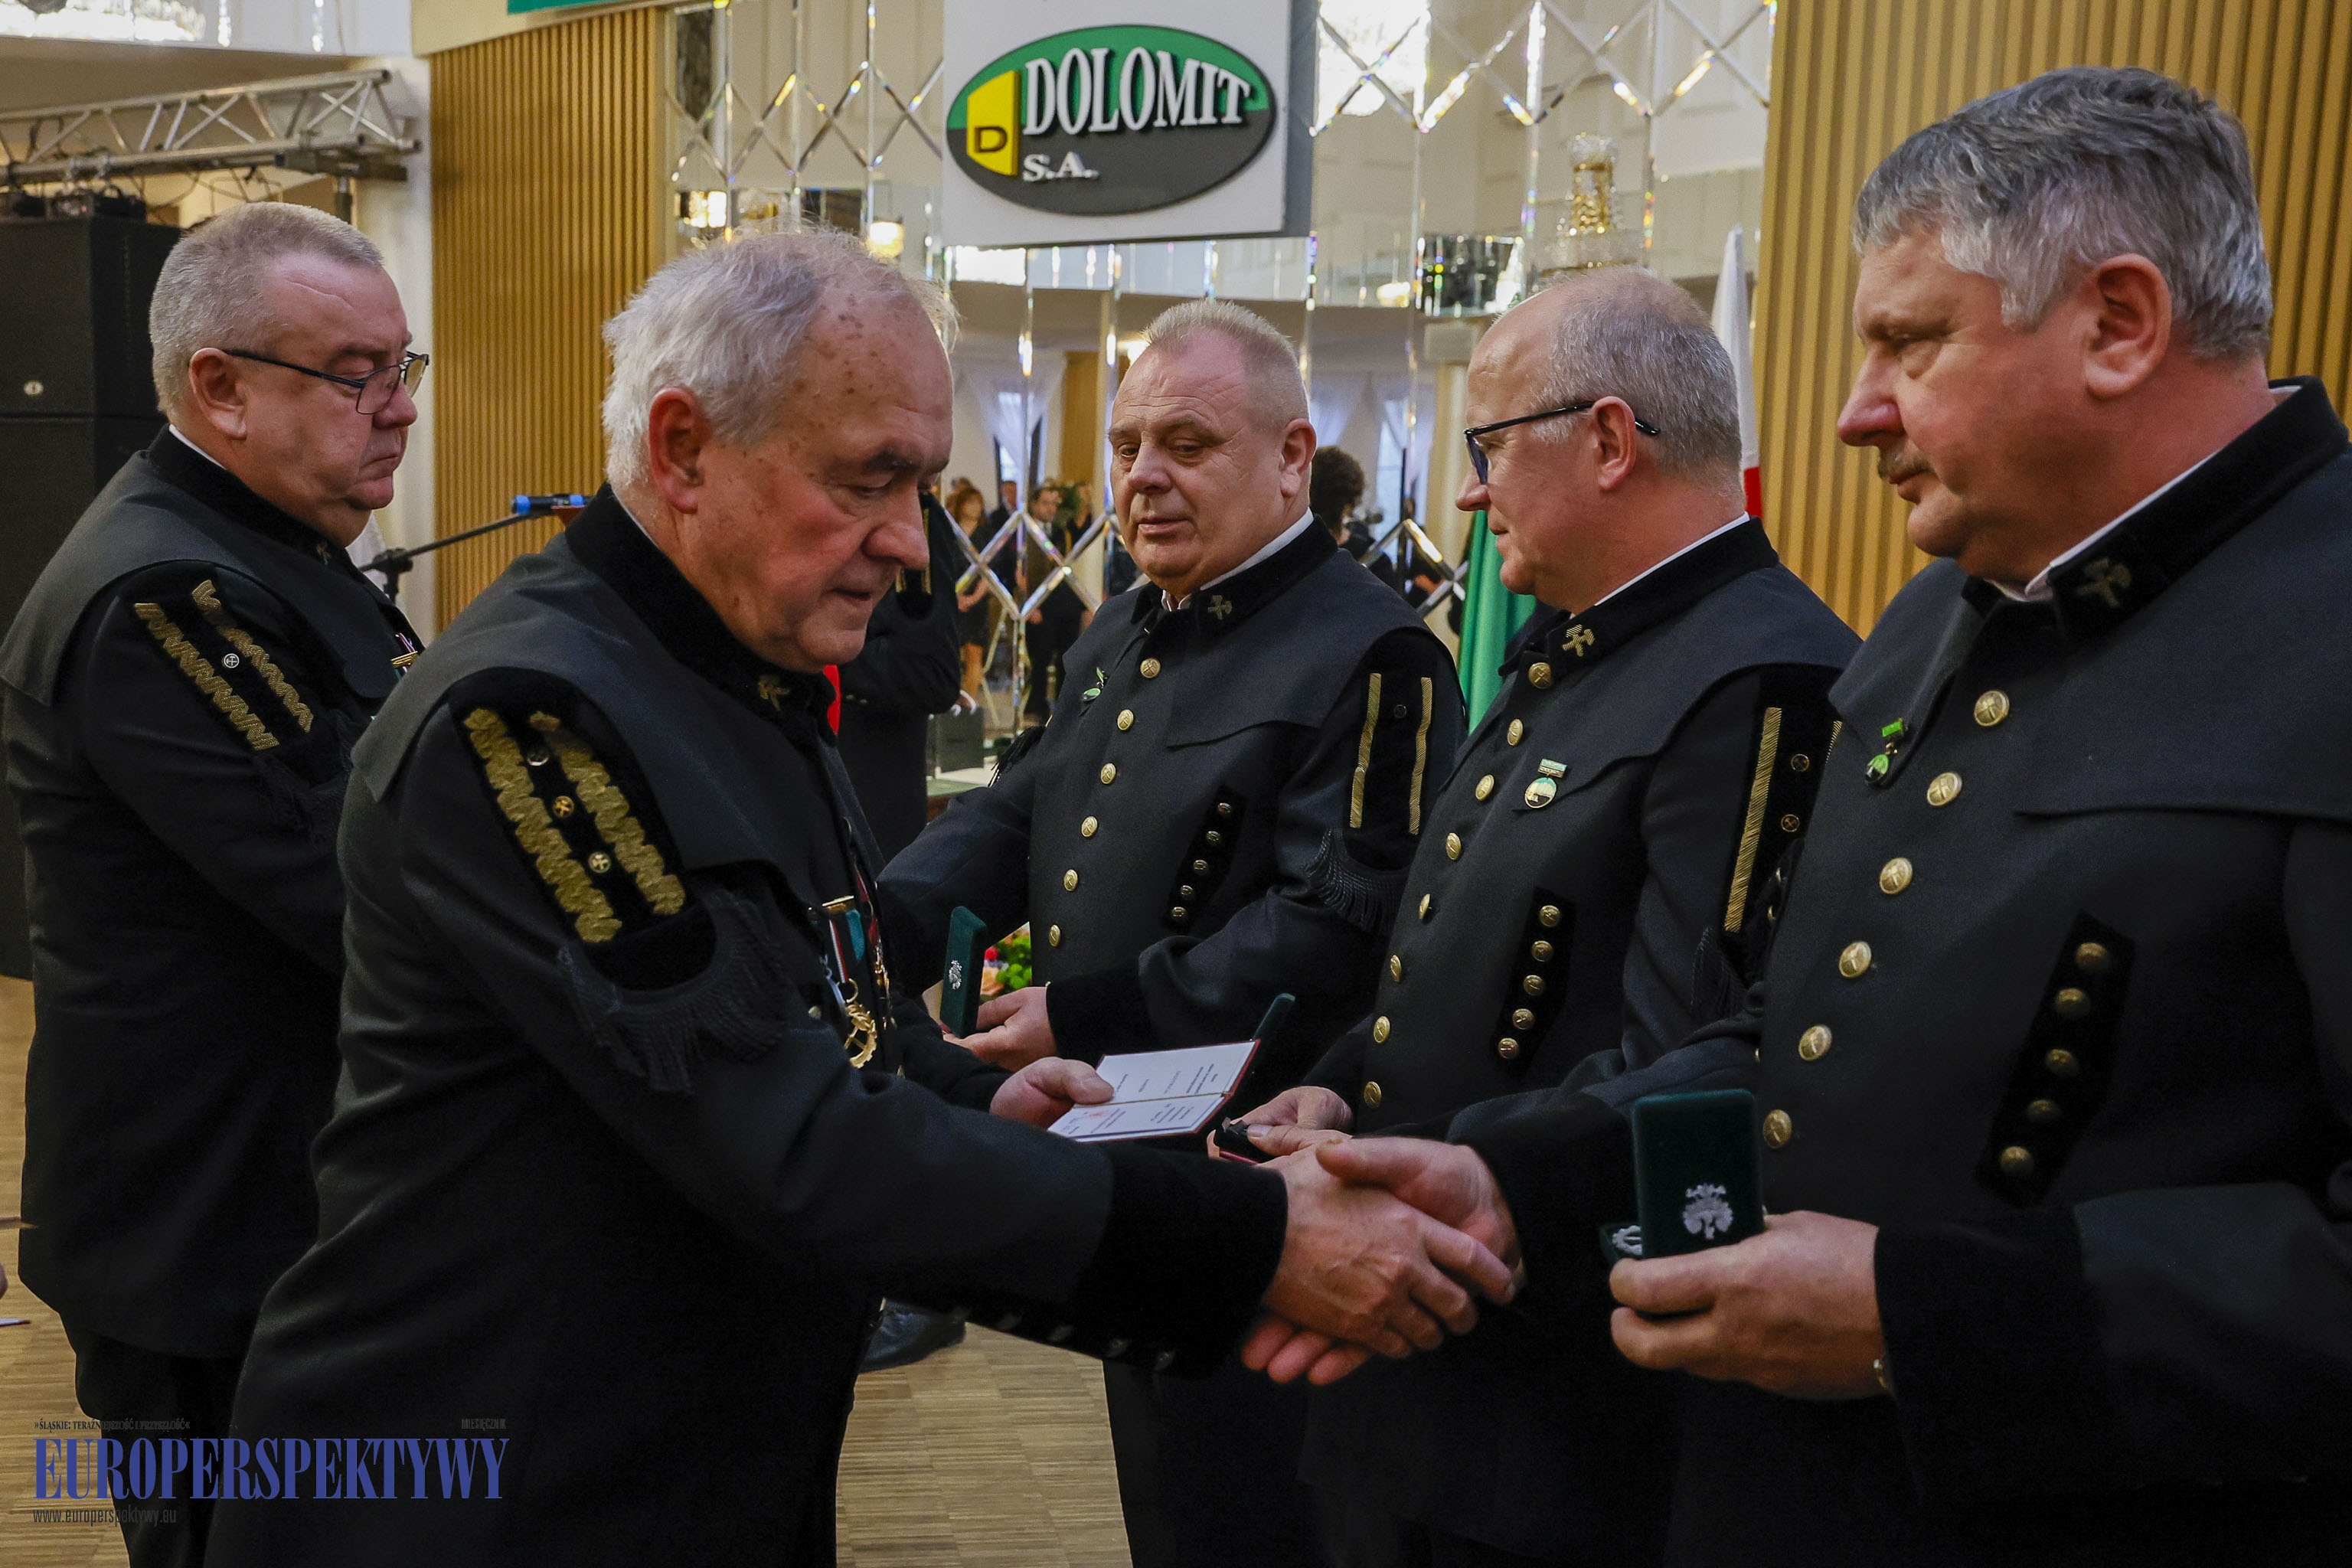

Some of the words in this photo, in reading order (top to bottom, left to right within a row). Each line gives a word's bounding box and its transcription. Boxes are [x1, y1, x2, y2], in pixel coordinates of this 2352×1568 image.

[1023, 47, 1251, 136] DOLOMIT
[973, 126, 1008, 153] D
[1023, 152, 1099, 182] S.A.
